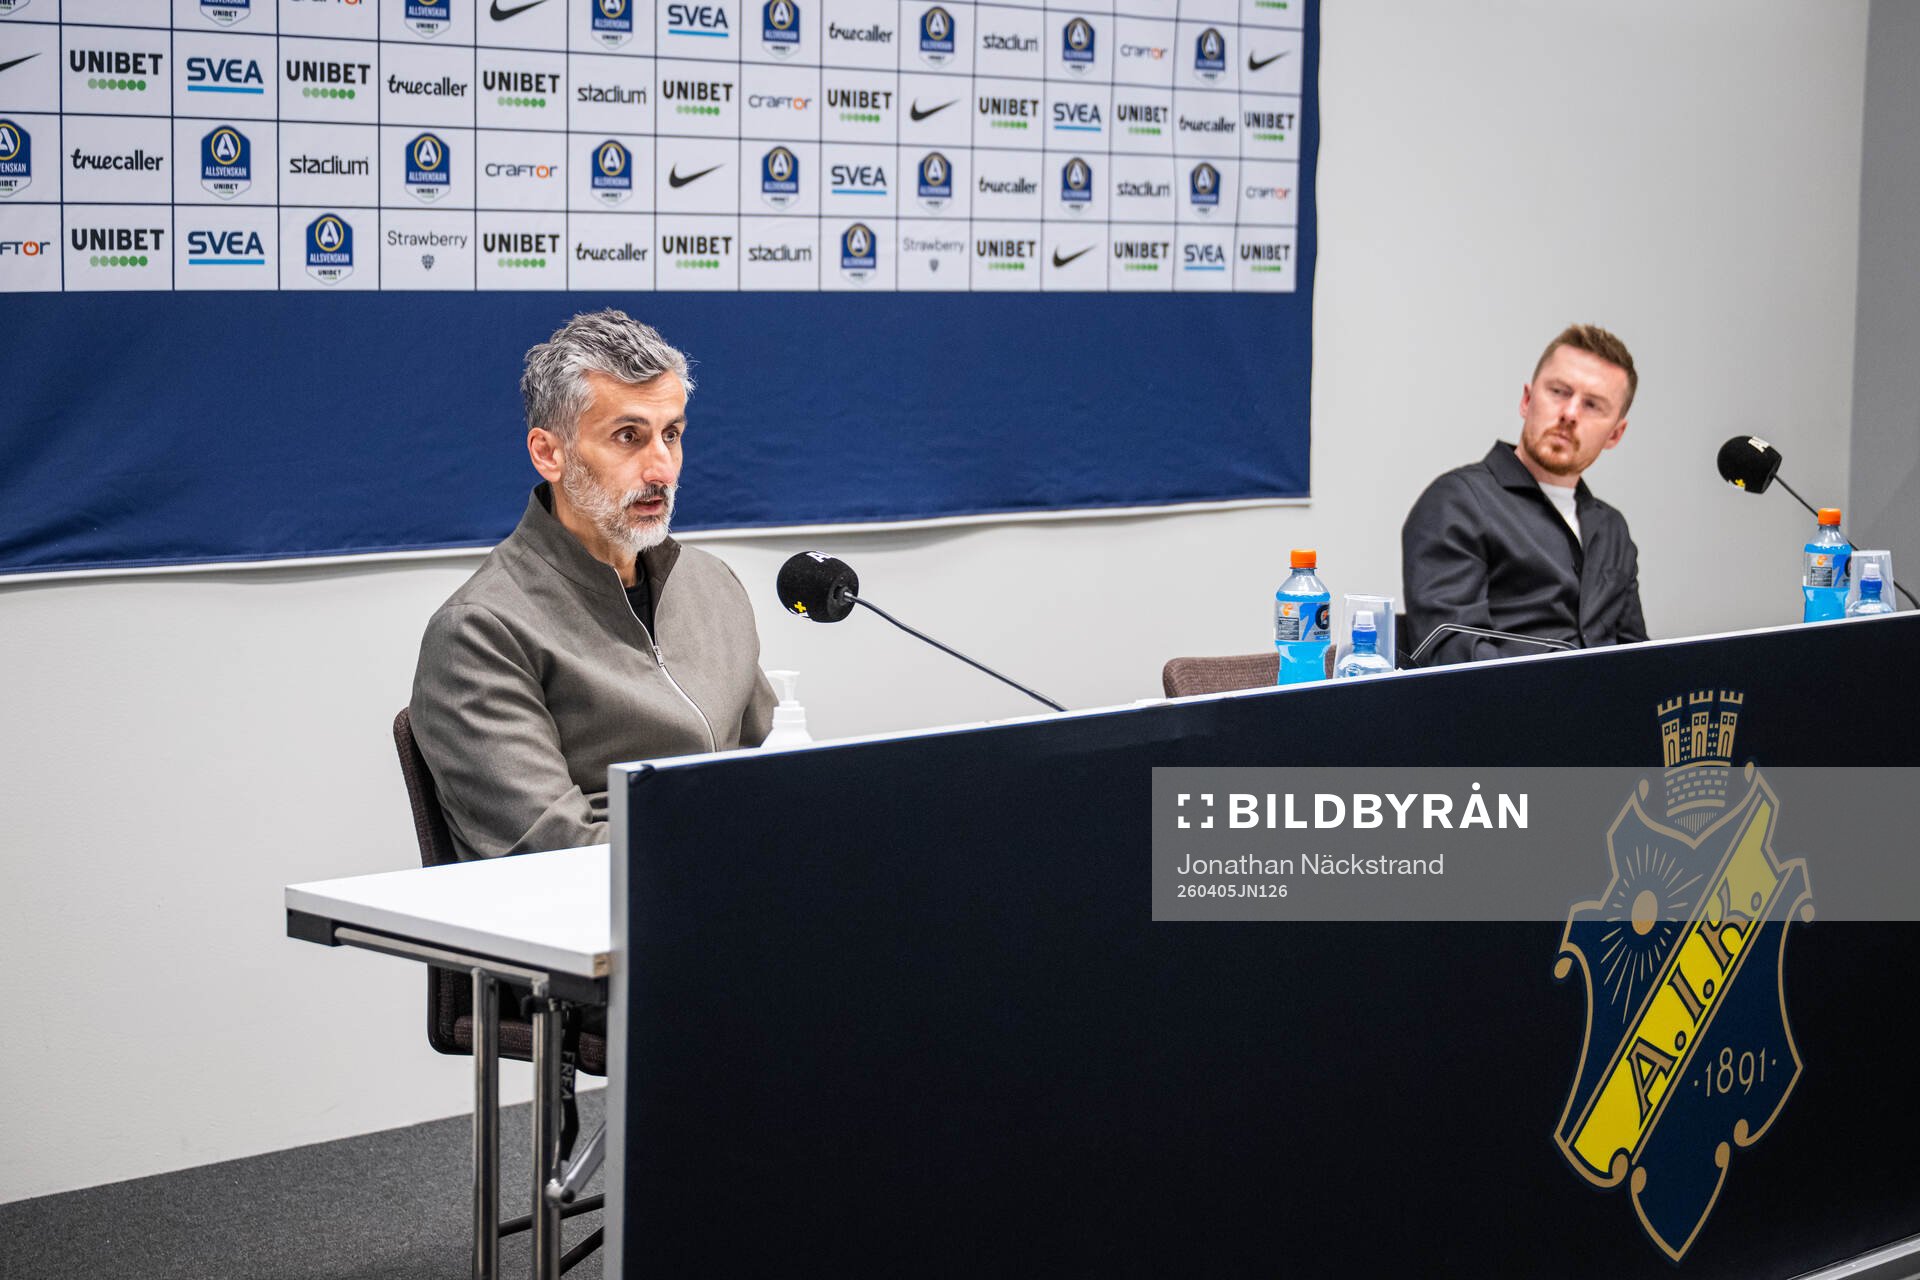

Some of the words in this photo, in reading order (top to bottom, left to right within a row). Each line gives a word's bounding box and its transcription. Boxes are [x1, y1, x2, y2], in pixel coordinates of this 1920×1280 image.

[668, 4, 728, 28] SVEA
[829, 22, 892, 42] truecaller
[70, 50, 163, 75] UNIBET
[187, 58, 263, 84] SVEA
[287, 60, 370, 84] UNIBET
[388, 74, 467, 96] truecaller
[483, 71, 560, 93] UNIBET
[663, 80, 733, 101] UNIBET
[578, 84, 646, 104] stadium
[828, 89, 892, 109] UNIBET
[979, 97, 1039, 116] UNIBET
[1053, 103, 1101, 123] SVEA
[1118, 105, 1168, 123] UNIBET
[1245, 112, 1294, 130] UNIBET
[71, 148, 163, 171] truecaller
[290, 155, 368, 175] stadium
[205, 166, 247, 177] ALLSVENSKAN
[831, 165, 887, 186] SVEA
[72, 229, 164, 250] UNIBET
[188, 231, 264, 255] SVEA
[388, 230, 467, 248] Strawberry
[484, 234, 560, 253] UNIBET
[663, 236, 732, 254] UNIBET
[903, 237, 964, 253] Strawberry
[977, 240, 1035, 258] UNIBET
[576, 243, 647, 261] truecaller
[1115, 242, 1169, 259] UNIBET
[1184, 244, 1225, 263] SVEA
[1241, 244, 1290, 260] UNIBET
